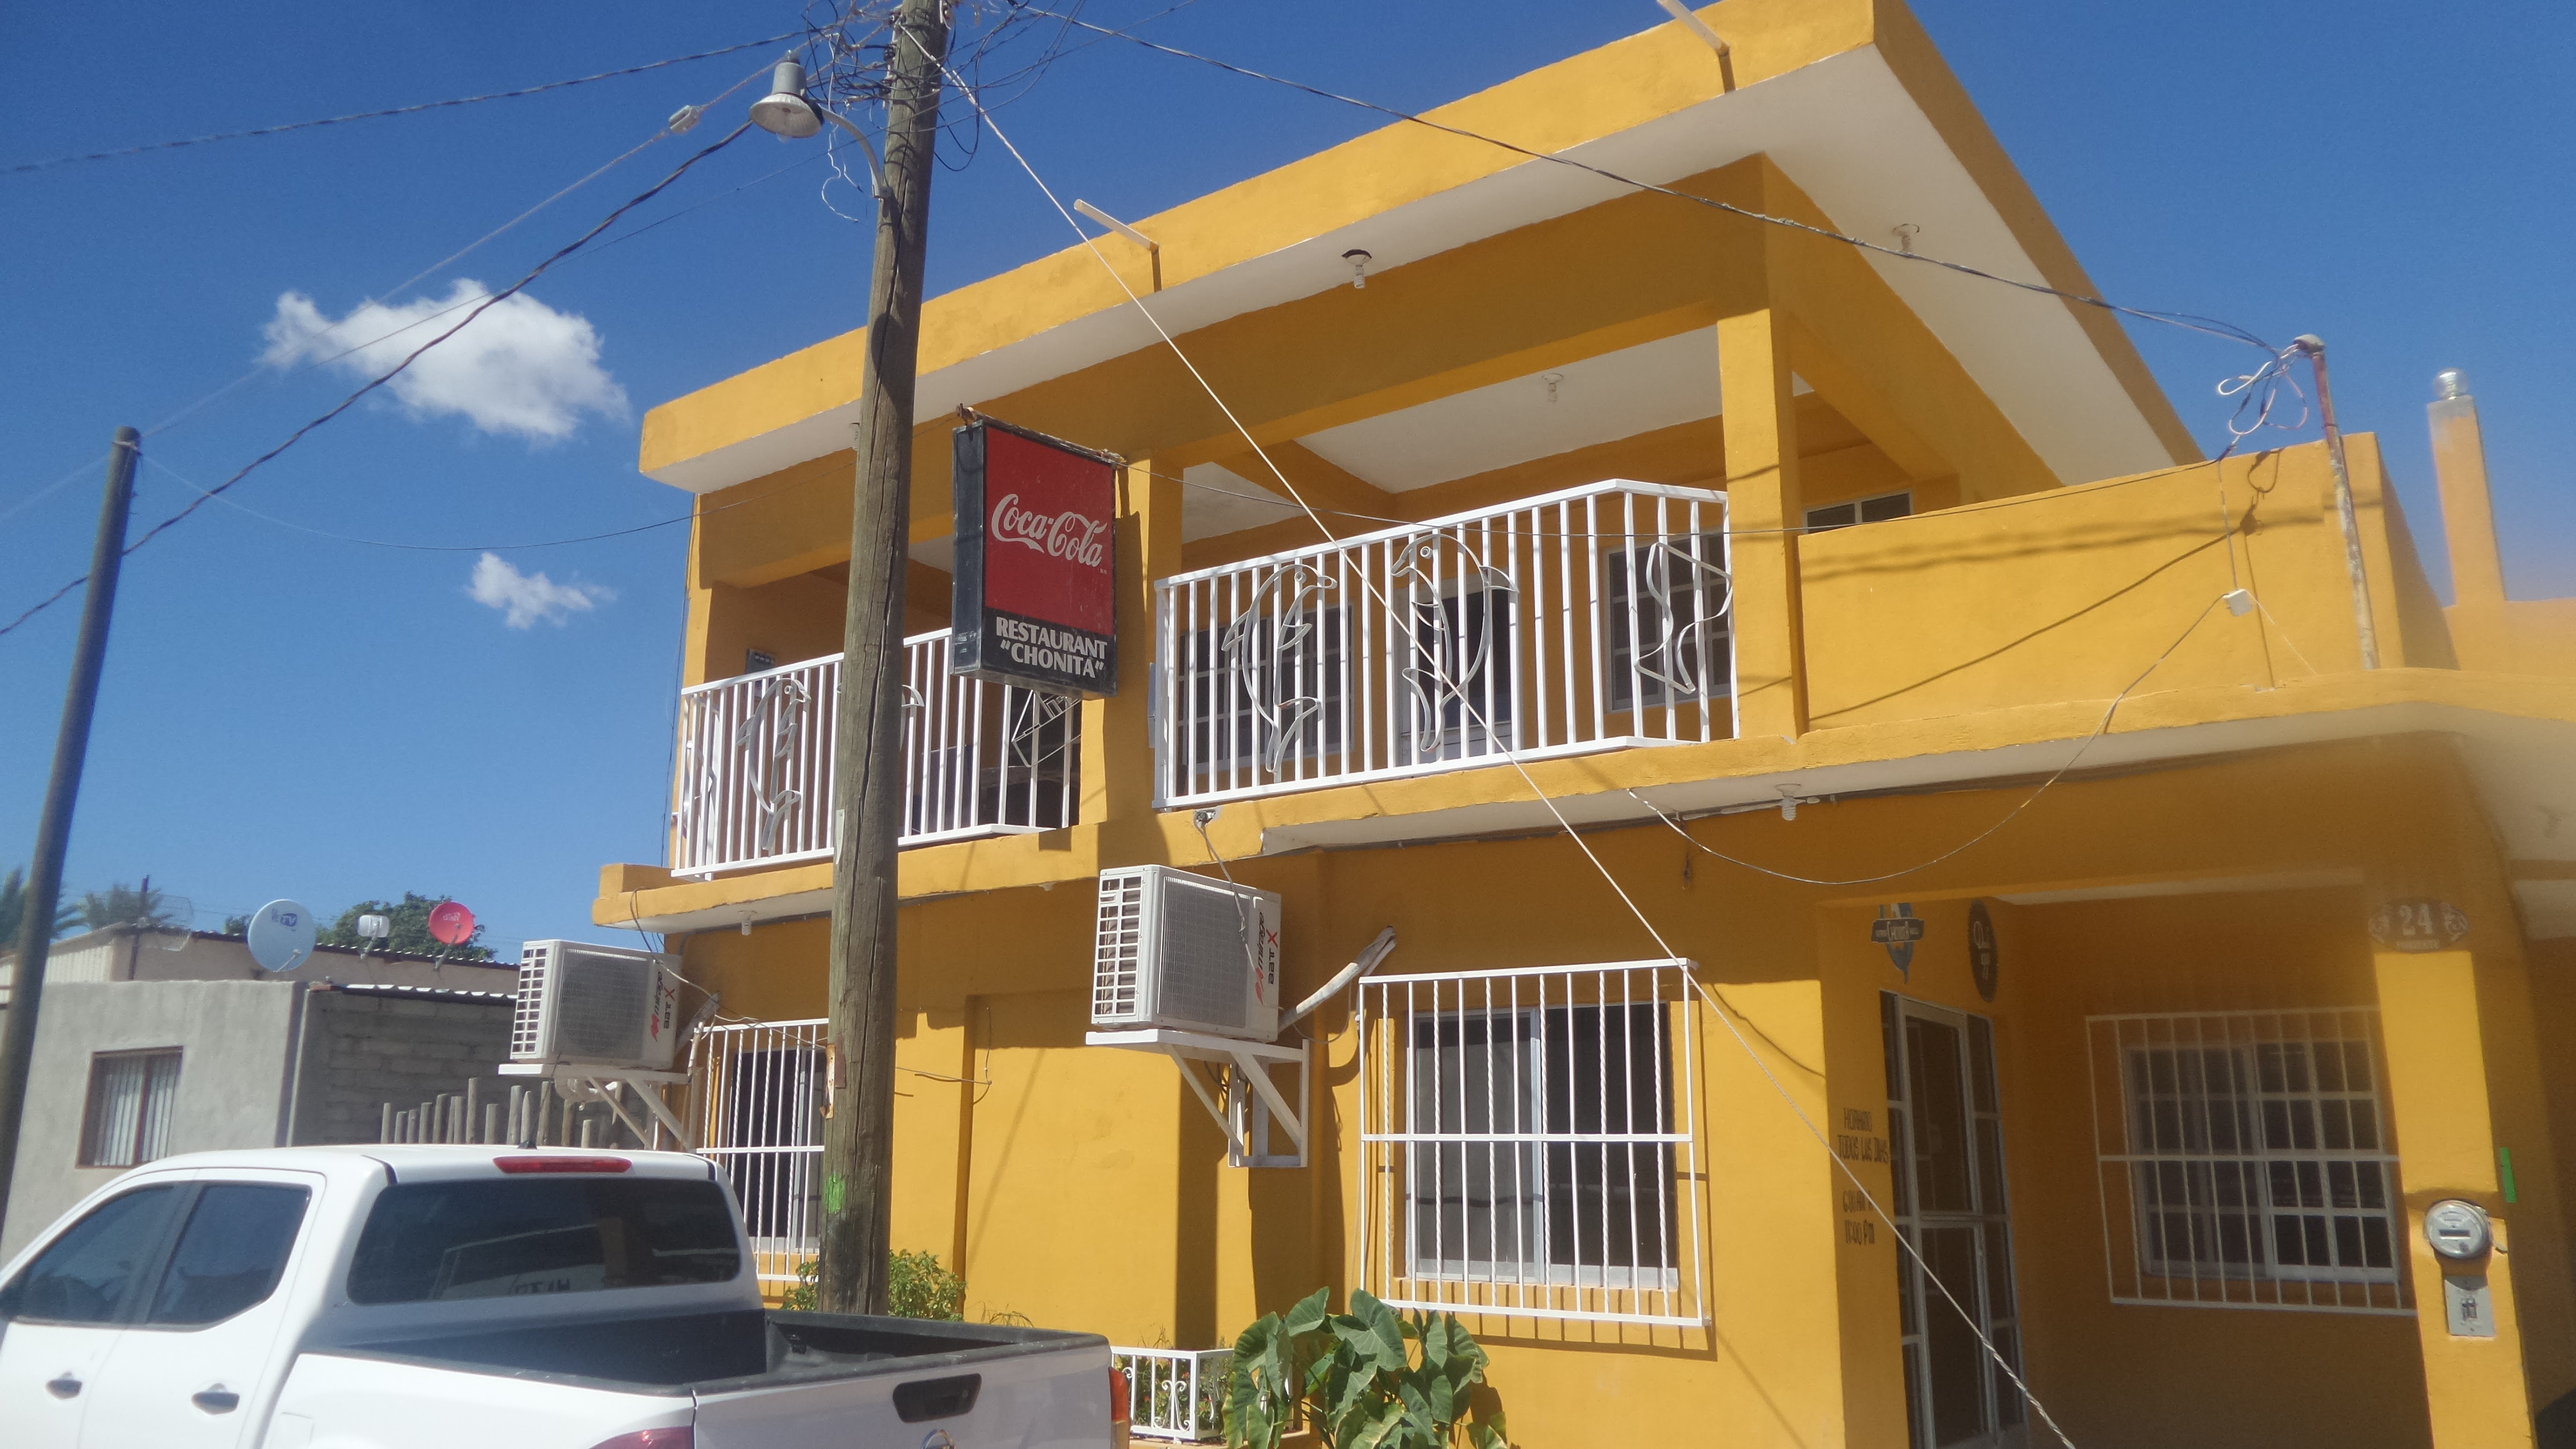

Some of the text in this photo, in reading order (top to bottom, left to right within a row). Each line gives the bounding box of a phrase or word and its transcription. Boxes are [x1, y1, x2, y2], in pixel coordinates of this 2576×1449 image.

[992, 494, 1107, 567] Coca-Cola
[996, 617, 1107, 659] RESTAURANT
[1000, 639, 1104, 678] "CHONITA"
[2399, 903, 2433, 935] 24
[1257, 911, 1265, 970] mirage
